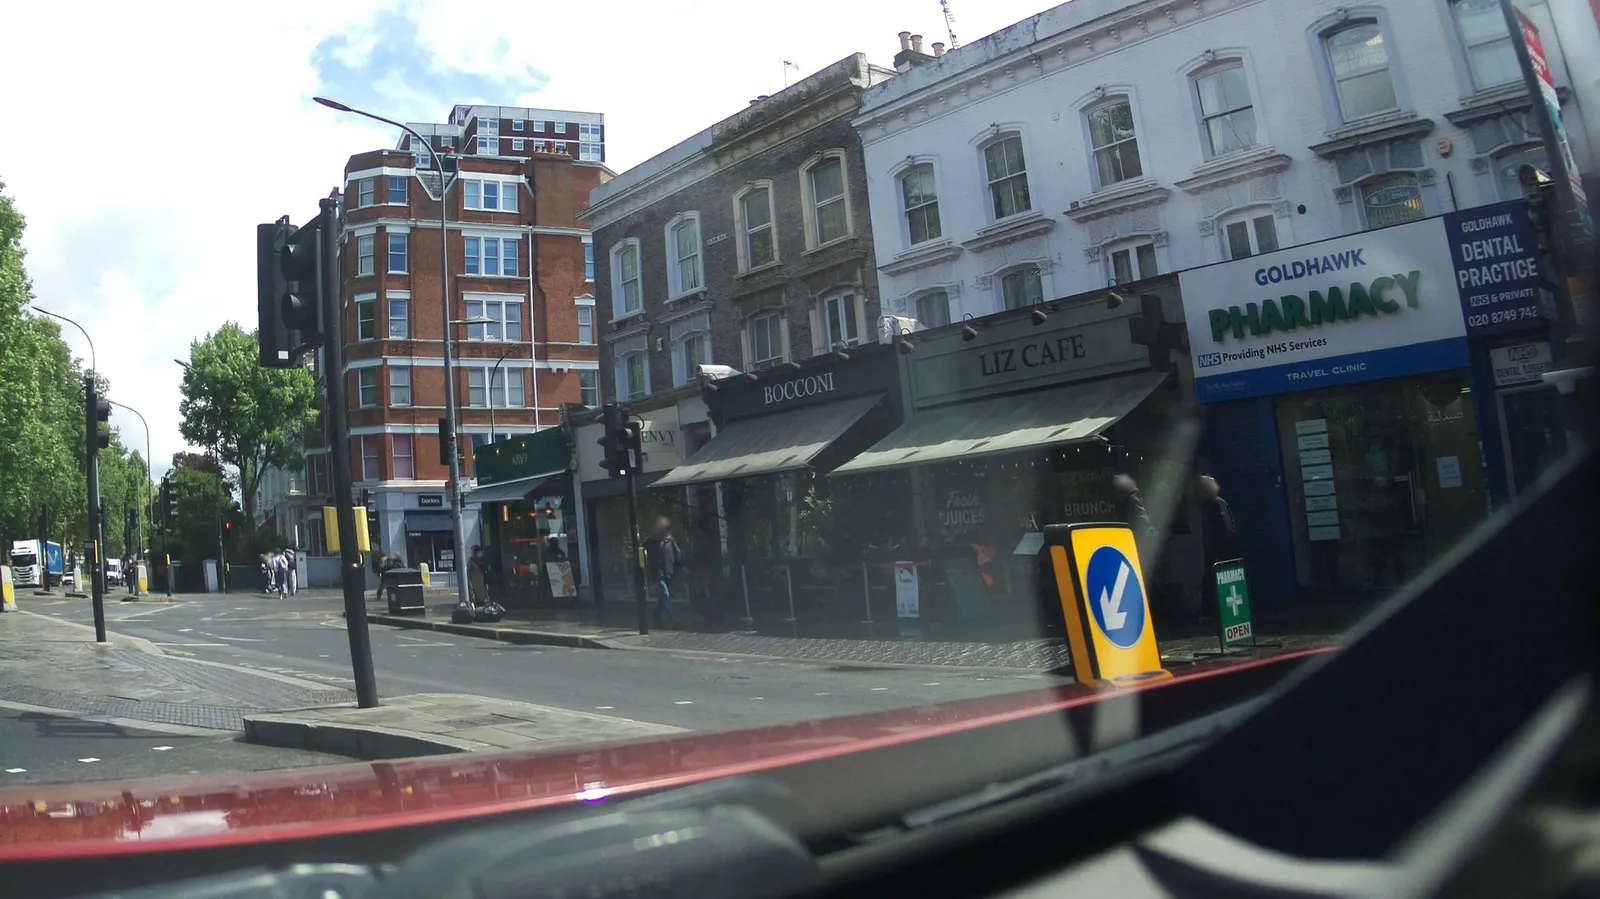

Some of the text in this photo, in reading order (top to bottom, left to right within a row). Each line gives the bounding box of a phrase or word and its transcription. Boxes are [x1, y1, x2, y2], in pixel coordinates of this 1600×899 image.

[1461, 213, 1513, 233] GOLDHAWK
[1461, 234, 1524, 262] DENTAL
[1255, 248, 1366, 286] GOLDHAWK
[1458, 257, 1538, 289] PRACTICE
[1208, 270, 1421, 343] PHARMACY
[1470, 288, 1535, 307] NHS & PRIVATE
[1468, 313, 1489, 327] 020
[1491, 309, 1517, 324] 8749
[981, 335, 1086, 377] LIZ CAFE
[1198, 338, 1327, 368] NHS Providing NHS Services
[1286, 362, 1367, 381] TRAVEL CLINIC
[763, 372, 835, 404] BOCCONI
[640, 430, 676, 443] ENVY
[944, 508, 986, 526] JUICES
[1064, 499, 1116, 517] BRUNCH
[1227, 624, 1250, 640] OPEN
